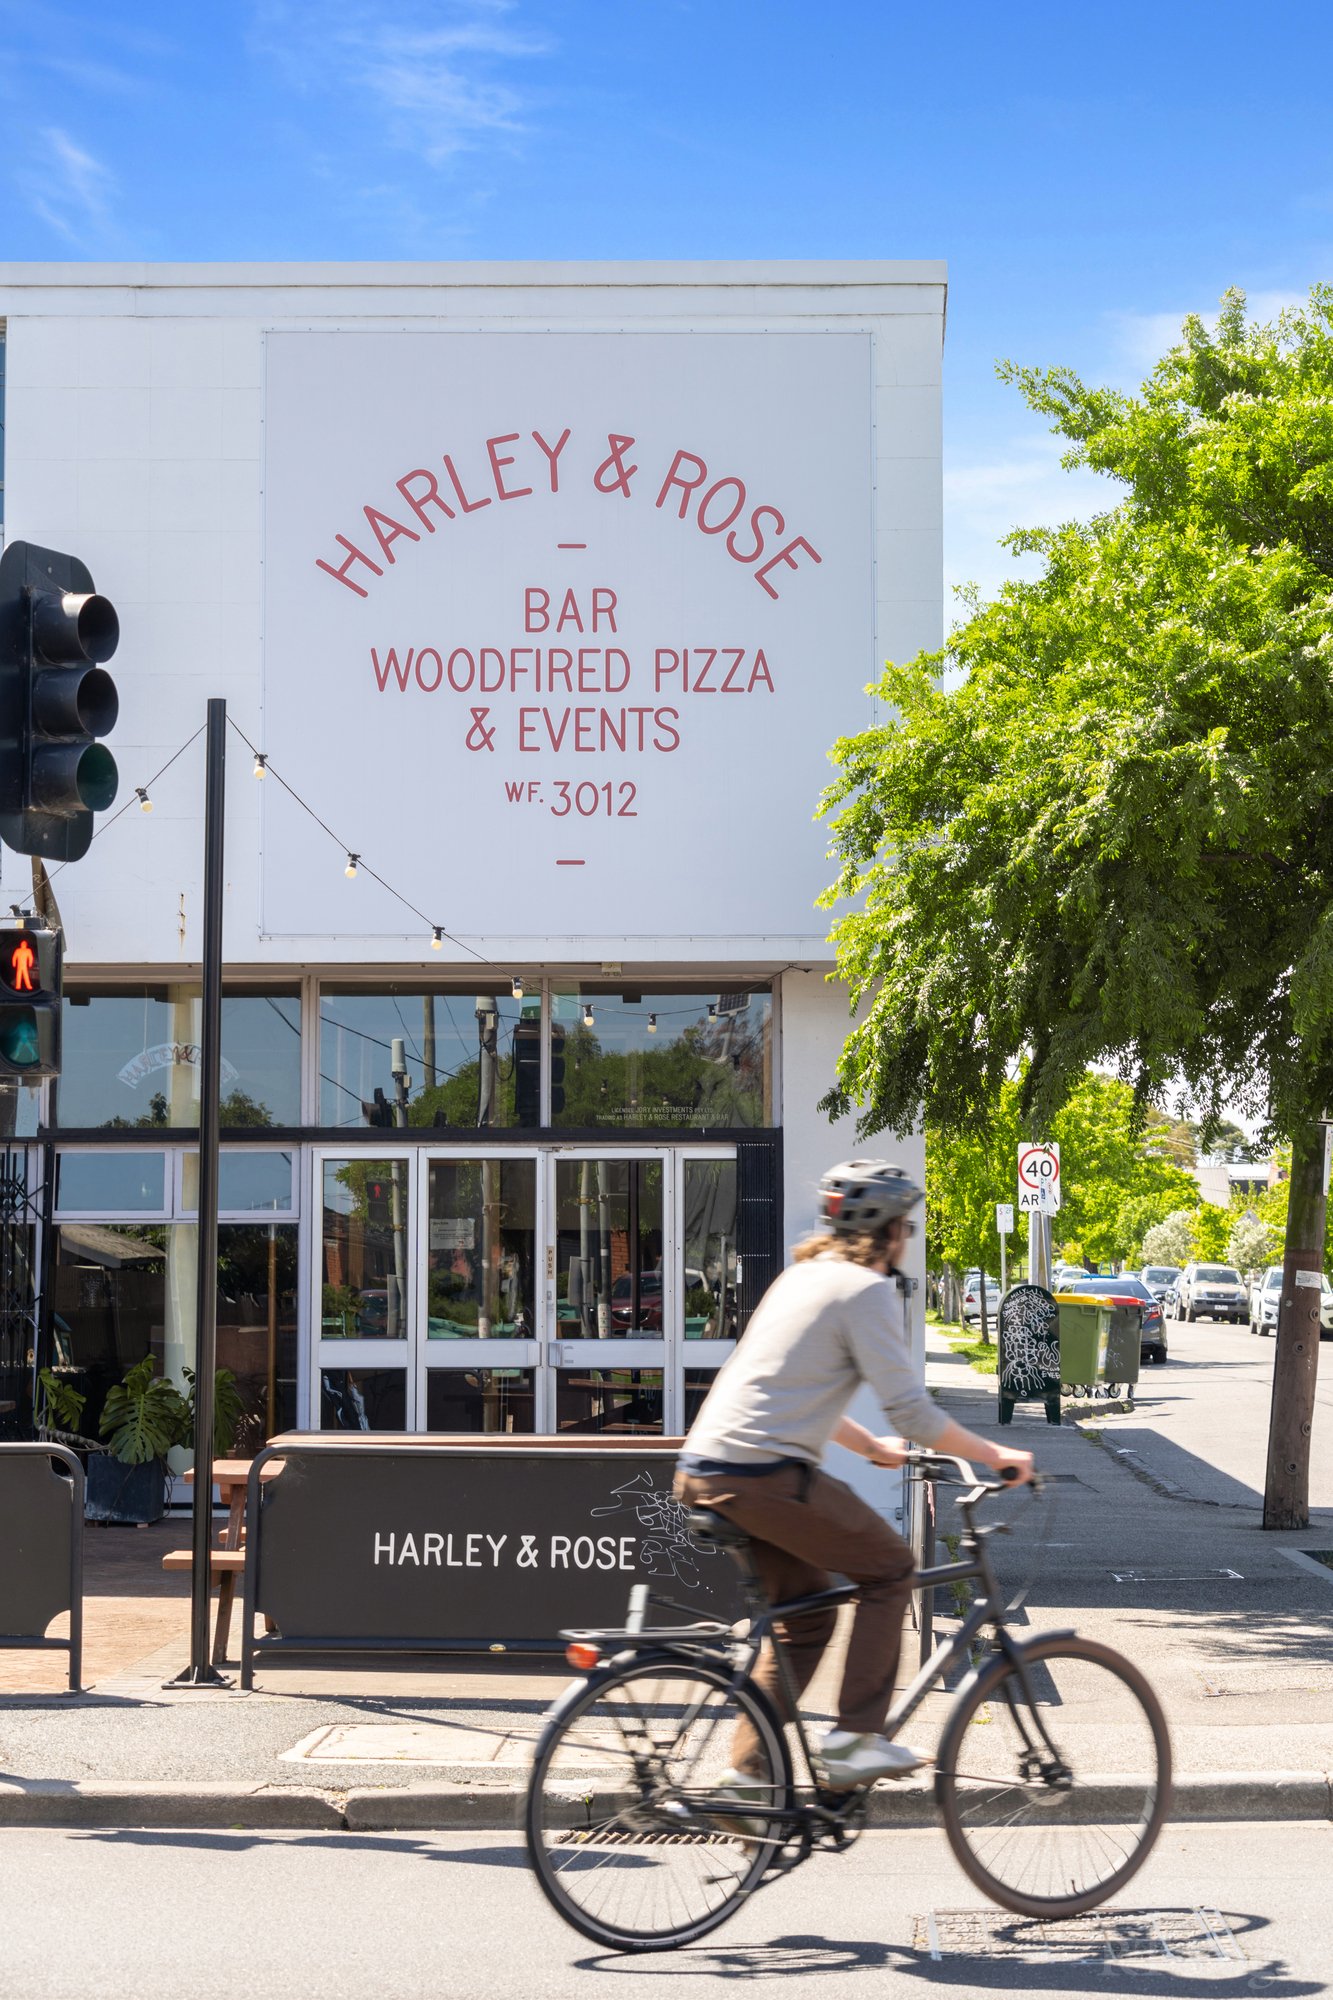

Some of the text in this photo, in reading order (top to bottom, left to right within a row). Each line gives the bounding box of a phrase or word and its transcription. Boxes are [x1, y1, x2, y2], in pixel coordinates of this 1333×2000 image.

[316, 429, 822, 600] HARLEY & ROSE
[524, 587, 618, 633] BAR
[370, 647, 775, 693] WOODFIRED PIZZA
[465, 707, 680, 752] & EVENTS
[505, 781, 637, 816] WF. 3012
[623, 1113, 647, 1121] HARLEY
[647, 1113, 653, 1121] &
[654, 1113, 671, 1121] ROSE
[671, 1113, 710, 1121] RESTAURANT
[652, 1106, 693, 1114] INVESTMENTS
[1025, 1160, 1052, 1177] 40
[374, 1531, 637, 1571] HARLEY & ROSE
